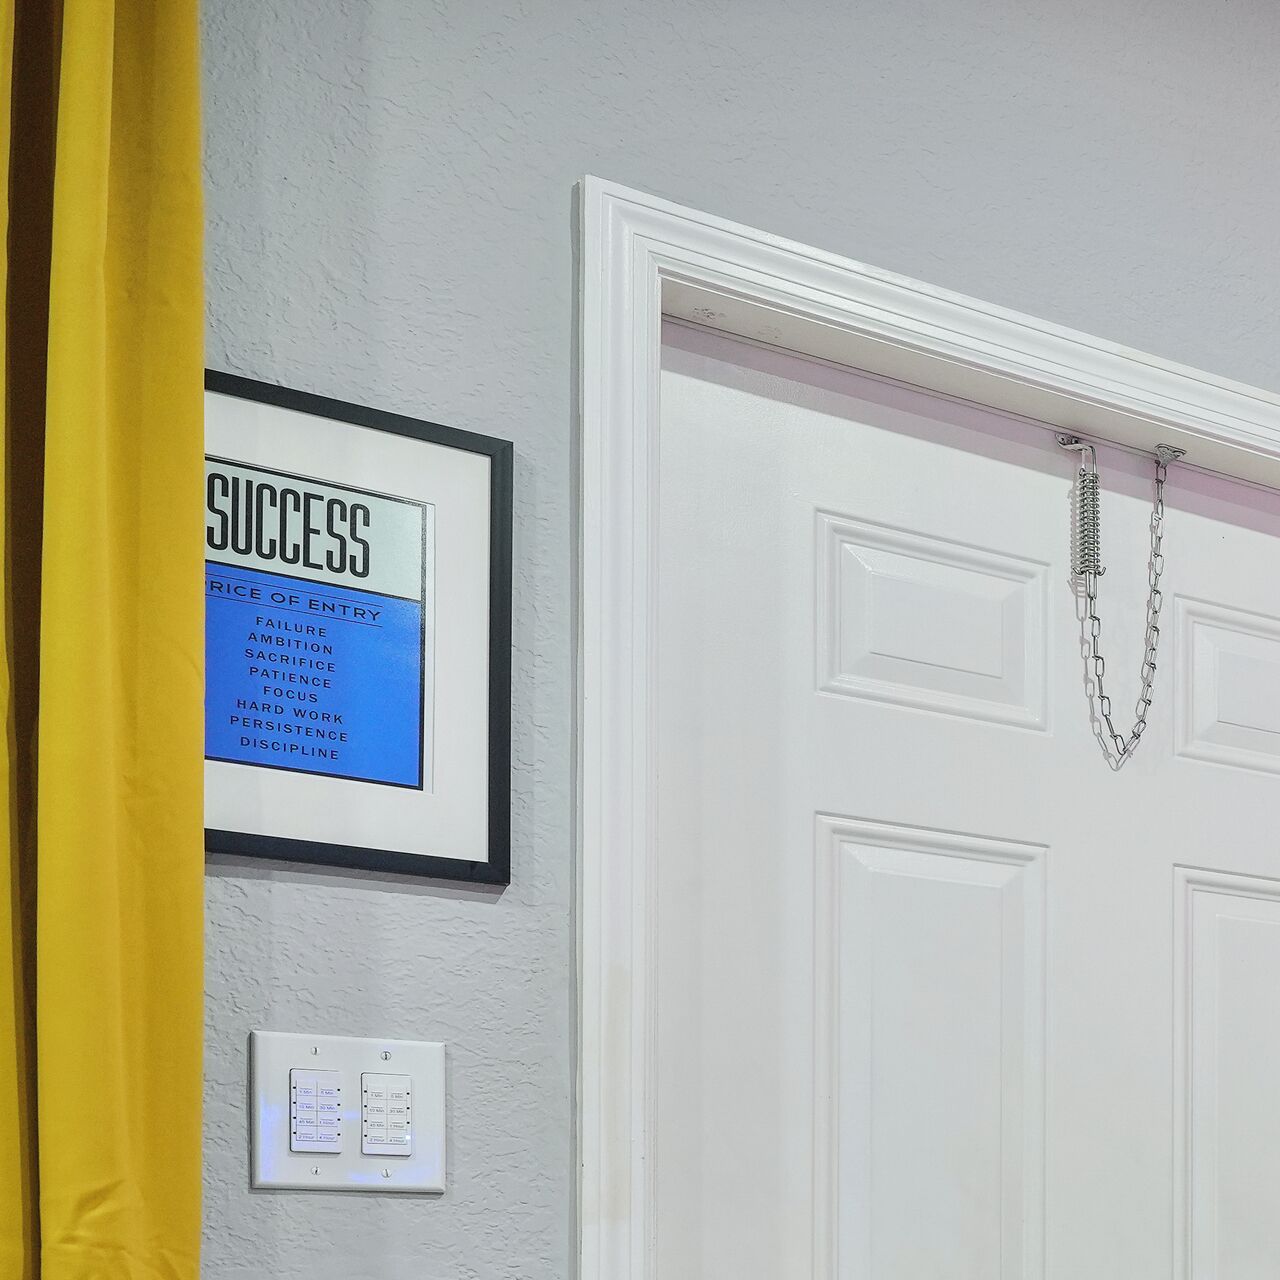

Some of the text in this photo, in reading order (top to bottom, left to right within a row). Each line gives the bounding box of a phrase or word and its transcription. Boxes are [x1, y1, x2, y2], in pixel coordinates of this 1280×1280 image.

[206, 472, 370, 579] SUCCESS
[206, 580, 382, 621] RICE OF ENTRY
[256, 616, 327, 638] FAILURE
[248, 632, 333, 655] AMBITION
[244, 648, 336, 672] SACRIFICE
[249, 666, 332, 688] PATIENCE
[263, 685, 318, 703] FOCUS
[237, 698, 343, 724] HARD WORK
[230, 715, 348, 742] PERSISTENCE
[240, 736, 339, 760] DISCIPLINE
